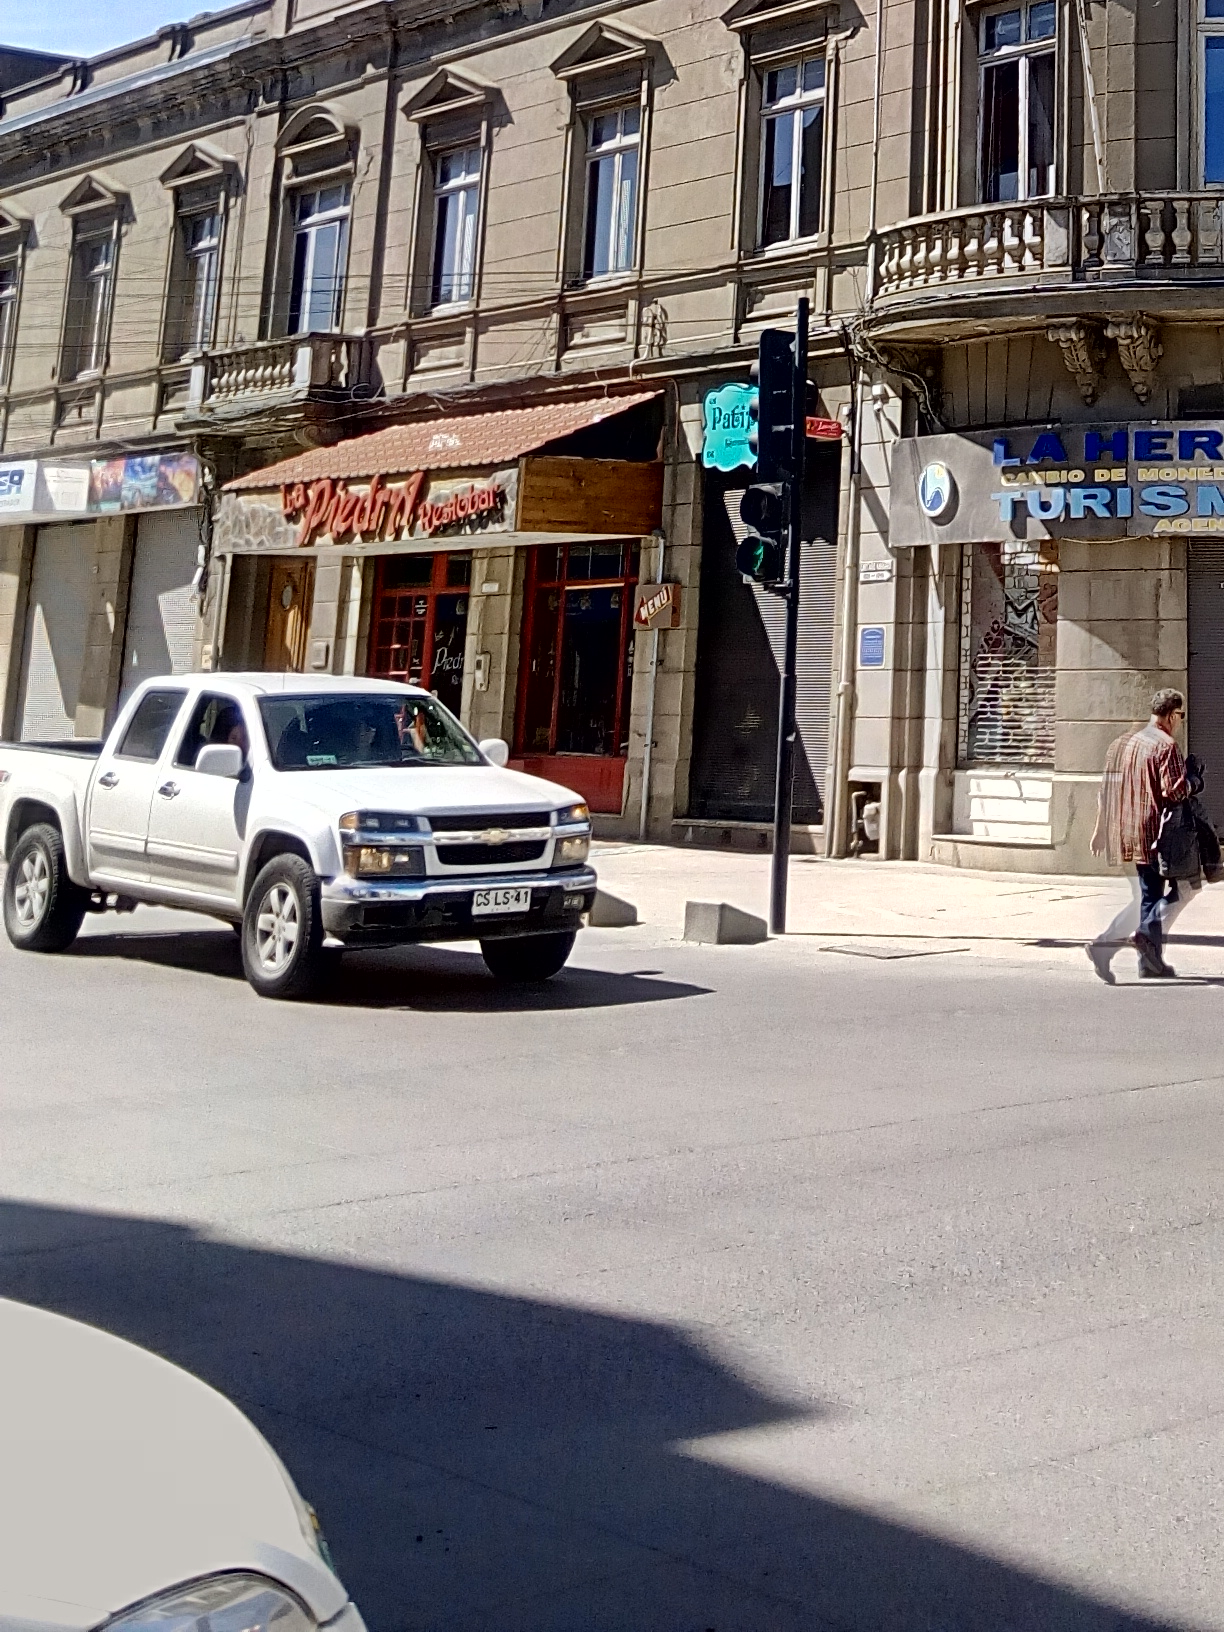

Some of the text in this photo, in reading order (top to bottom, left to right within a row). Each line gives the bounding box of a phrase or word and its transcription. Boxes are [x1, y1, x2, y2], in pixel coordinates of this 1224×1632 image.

[993, 431, 1069, 466] LA
[1001, 469, 1086, 486] CAMBIO
[1094, 467, 1127, 482] DE
[280, 484, 307, 516] La
[475, 892, 490, 907] CS
